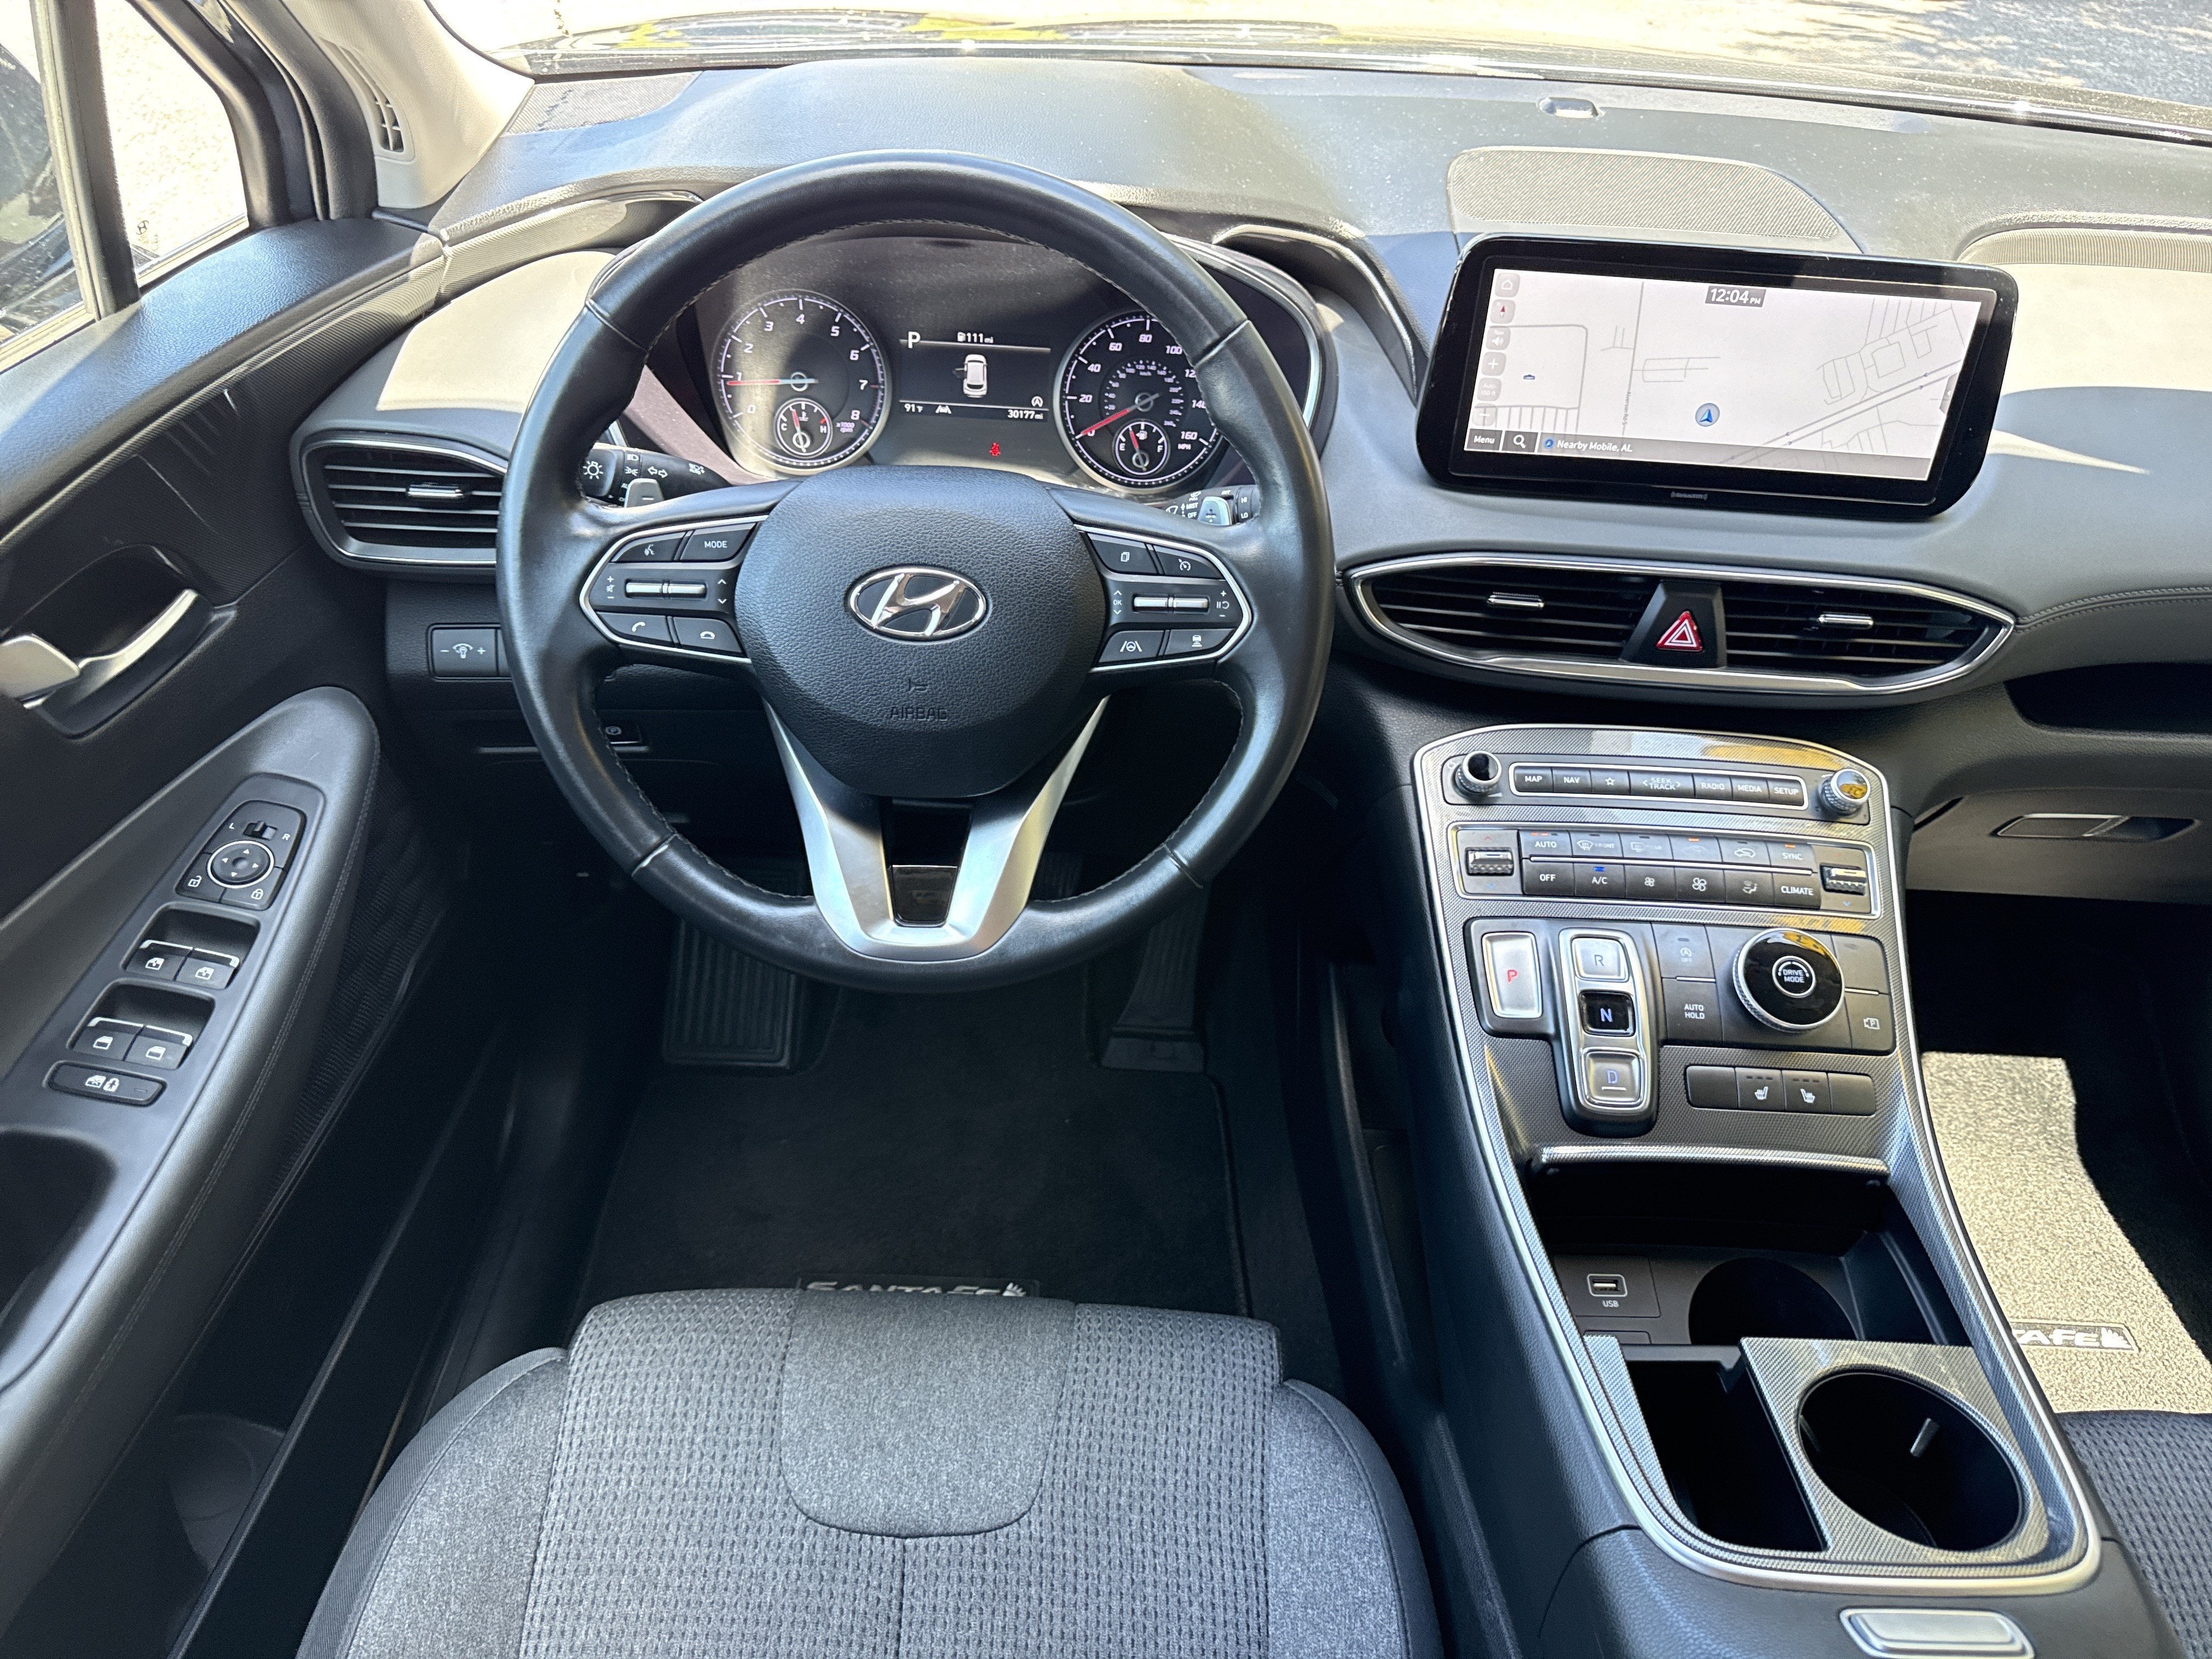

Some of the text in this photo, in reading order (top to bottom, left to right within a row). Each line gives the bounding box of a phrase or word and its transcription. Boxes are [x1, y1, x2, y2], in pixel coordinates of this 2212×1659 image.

[795, 314, 805, 324] 4
[764, 321, 774, 331] 3
[831, 326, 840, 336] 5
[908, 331, 921, 348] P
[1139, 334, 1152, 343] 80
[743, 343, 754, 353] 2
[1109, 342, 1122, 352] 60
[1166, 345, 1182, 354] 100
[850, 349, 859, 360] 6
[1087, 364, 1101, 373] 40
[1185, 369, 1197, 378] 12
[737, 372, 742, 381] 1
[859, 379, 868, 390] 7
[1079, 394, 1092, 403] 20
[747, 405, 756, 413] 0
[851, 410, 860, 420] 8
[1181, 431, 1198, 440] 160
[1474, 436, 1495, 444] Menu
[1557, 440, 1633, 453] Nearby Mobile, AL
[890, 707, 948, 721] AIRBAG
[1782, 852, 1803, 861] SYNC
[1592, 877, 1607, 885] A/C
[1781, 886, 1814, 896] CLIMATE
[1594, 954, 1605, 967] R
[1507, 969, 1519, 983] P
[1782, 968, 1804, 977] DRIVE
[1684, 1003, 1705, 1012] AUTO
[1600, 1008, 1613, 1023] N
[1685, 1012, 1705, 1020] HOLD
[1607, 1070, 1618, 1084] D
[1602, 1300, 1619, 1308] USB
